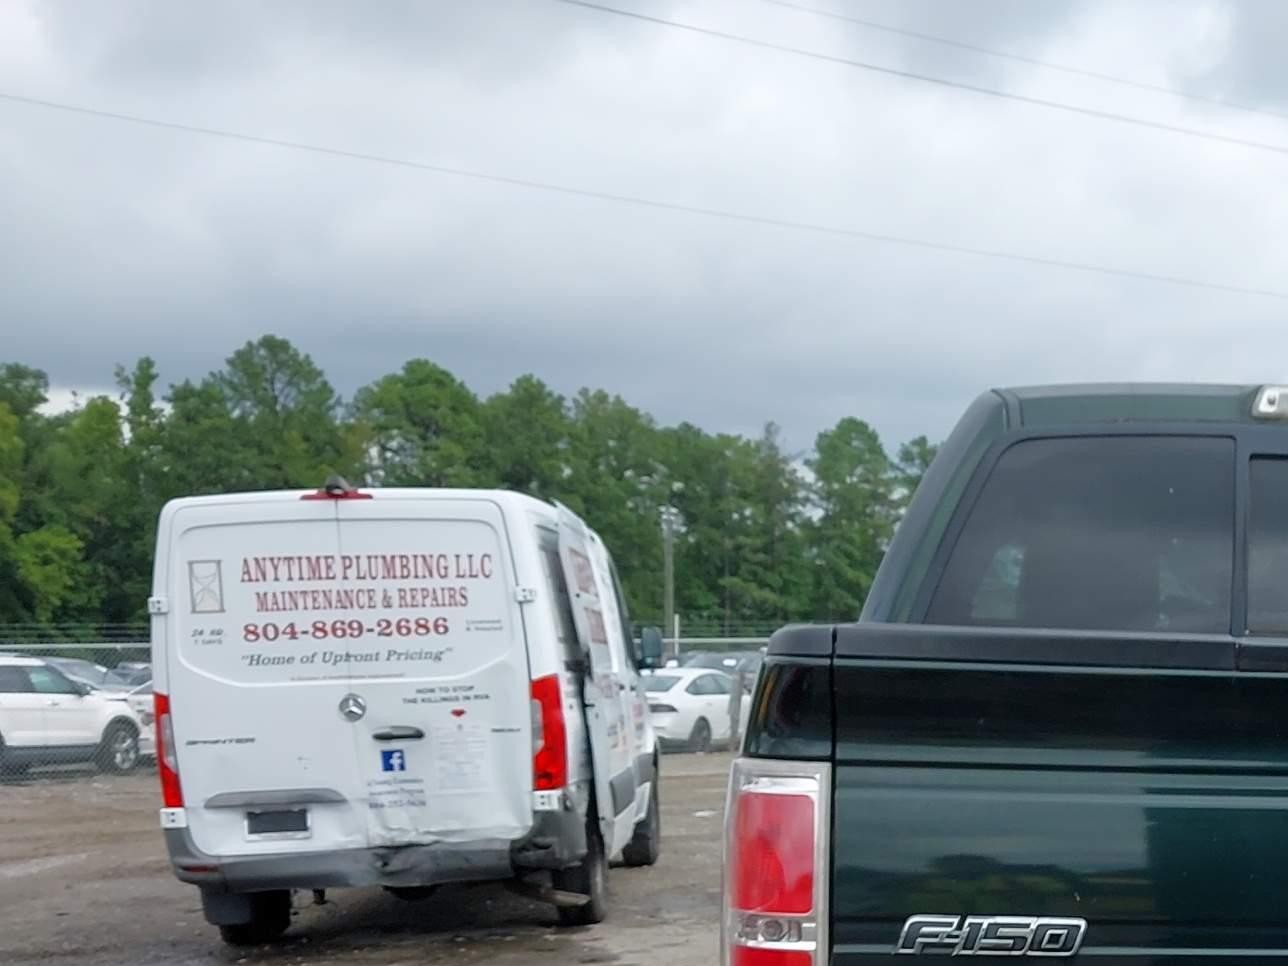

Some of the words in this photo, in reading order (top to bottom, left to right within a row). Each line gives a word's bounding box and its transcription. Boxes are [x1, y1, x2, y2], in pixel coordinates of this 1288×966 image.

[240, 555, 336, 583] ANYTIME
[340, 554, 449, 580] PLUMBING
[454, 553, 493, 579] LLC
[255, 588, 377, 612] MAINTENANCE
[381, 588, 393, 608] &
[397, 586, 469, 608] REPAIRS
[243, 616, 449, 643] 804-869-2686
[299, 651, 318, 665] of
[321, 650, 381, 667] Upfront
[893, 913, 1088, 957] F-150
